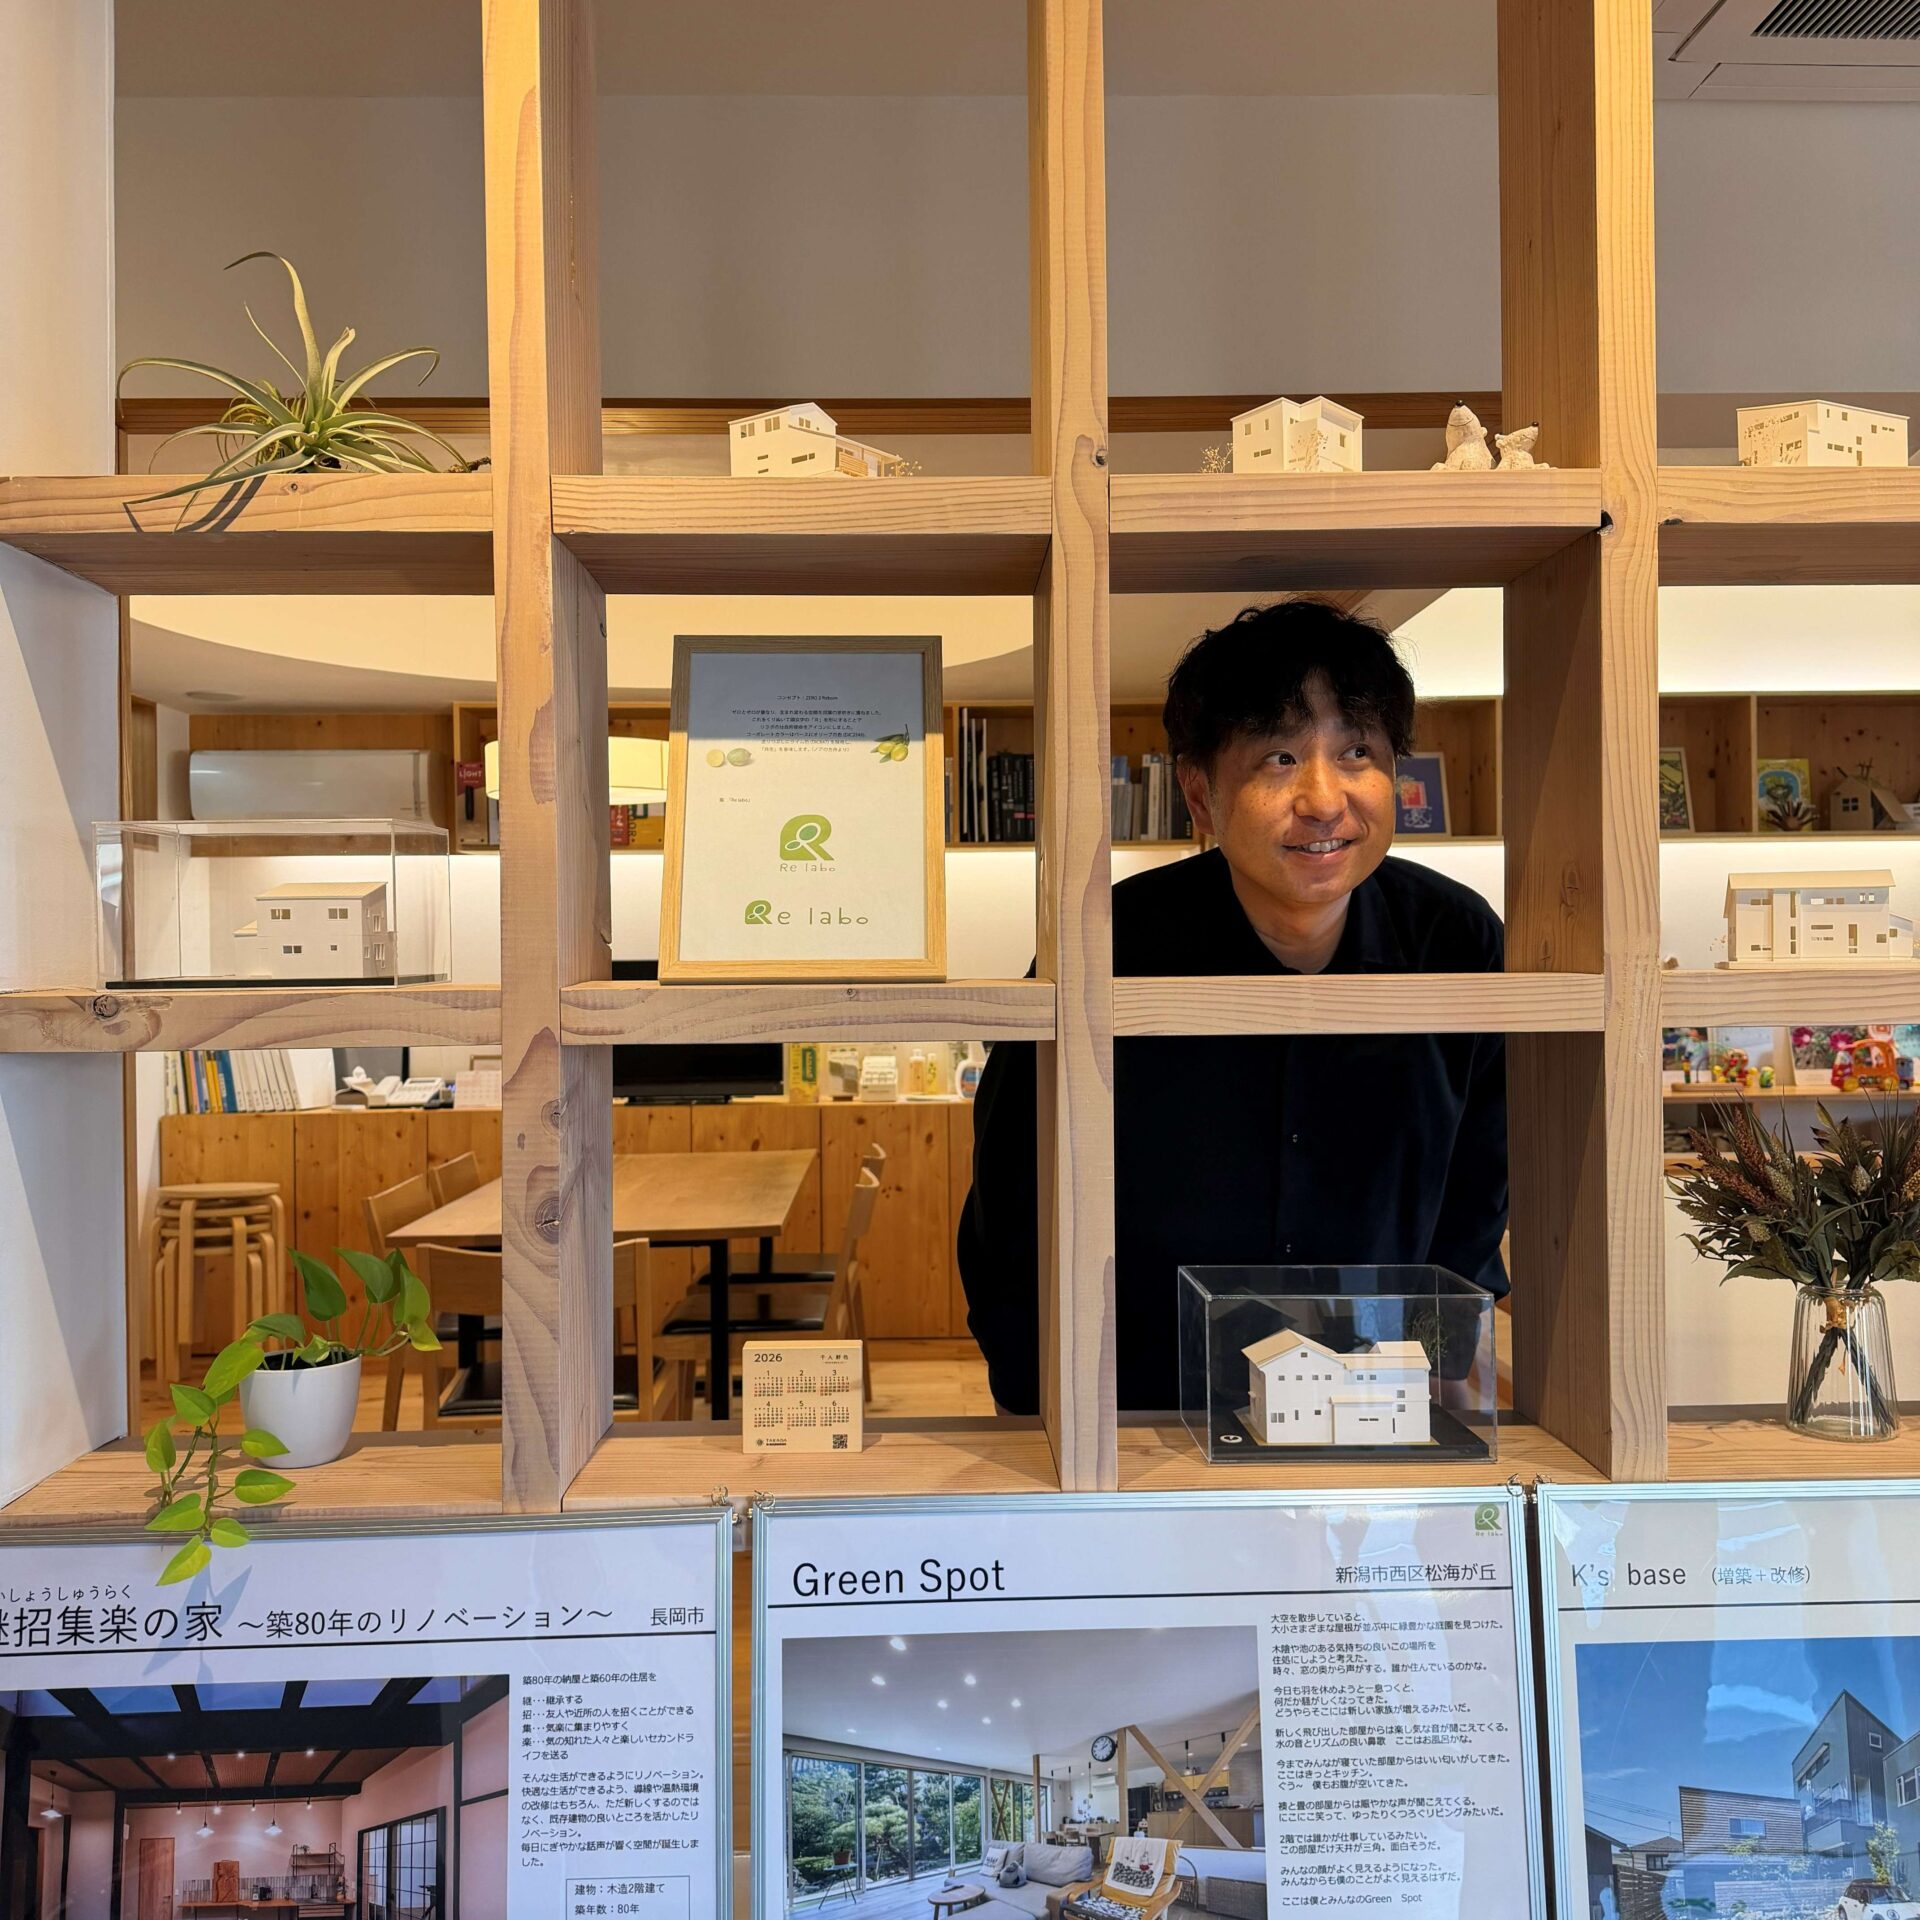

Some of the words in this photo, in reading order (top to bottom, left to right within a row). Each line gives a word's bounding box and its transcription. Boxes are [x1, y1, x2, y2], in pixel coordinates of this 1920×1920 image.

[780, 863, 797, 872] Re
[806, 863, 836, 872] labo
[810, 907, 868, 925] labo
[754, 1353, 782, 1362] 2026
[792, 1562, 905, 1597] Green
[918, 1558, 1006, 1600] Spot
[1335, 1563, 1498, 1585] 新潟市西区松海が丘
[1628, 1562, 1686, 1586] base
[650, 1605, 705, 1627] 長岡市
[1272, 1654, 1368, 1665] 住処にしようと考えた。
[522, 1672, 656, 1685] 築80年の納屋と築60年の住居を
[522, 1750, 569, 1760] イフを送る
[522, 1770, 704, 1783] そんな生活ができるようにリノベーション。
[1278, 1768, 1373, 1779] ここはきっとキッチン。
[522, 1798, 699, 1811] の改修はもちろん、ただ新しくするのでは
[522, 1829, 582, 1838] ノベーション。
[522, 1858, 544, 1867] した。
[1281, 1862, 1441, 1875] みんなの顔がよく見えるようになった。
[574, 1882, 665, 1895] 建物：木造2階建て
[1401, 1893, 1422, 1903] Spot
[574, 1903, 640, 1916] 築年数：80年
